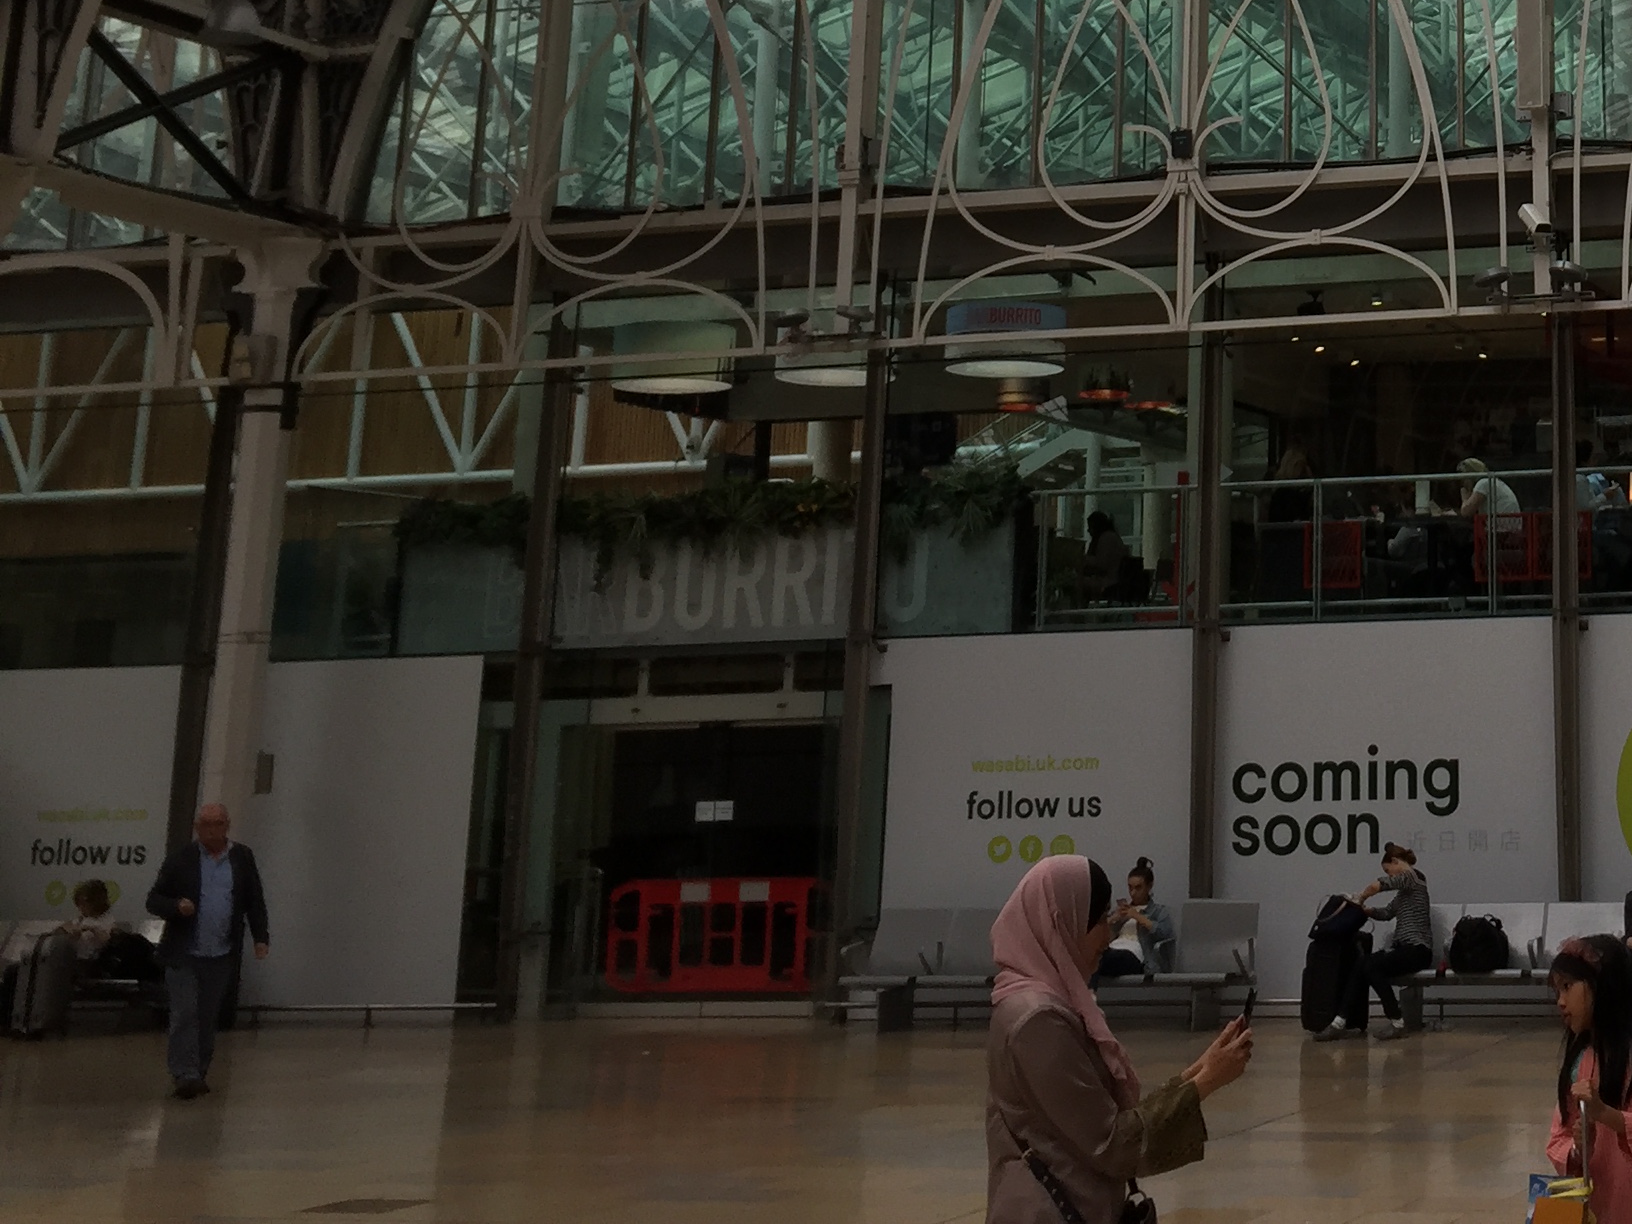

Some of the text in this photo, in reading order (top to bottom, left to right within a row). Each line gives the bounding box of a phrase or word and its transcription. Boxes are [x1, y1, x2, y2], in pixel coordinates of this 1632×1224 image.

[971, 755, 1100, 773] wasabi.uk.com
[1232, 744, 1459, 816] coming
[967, 790, 1102, 819] follow us
[1232, 813, 1380, 856] soon
[31, 838, 147, 865] follow us
